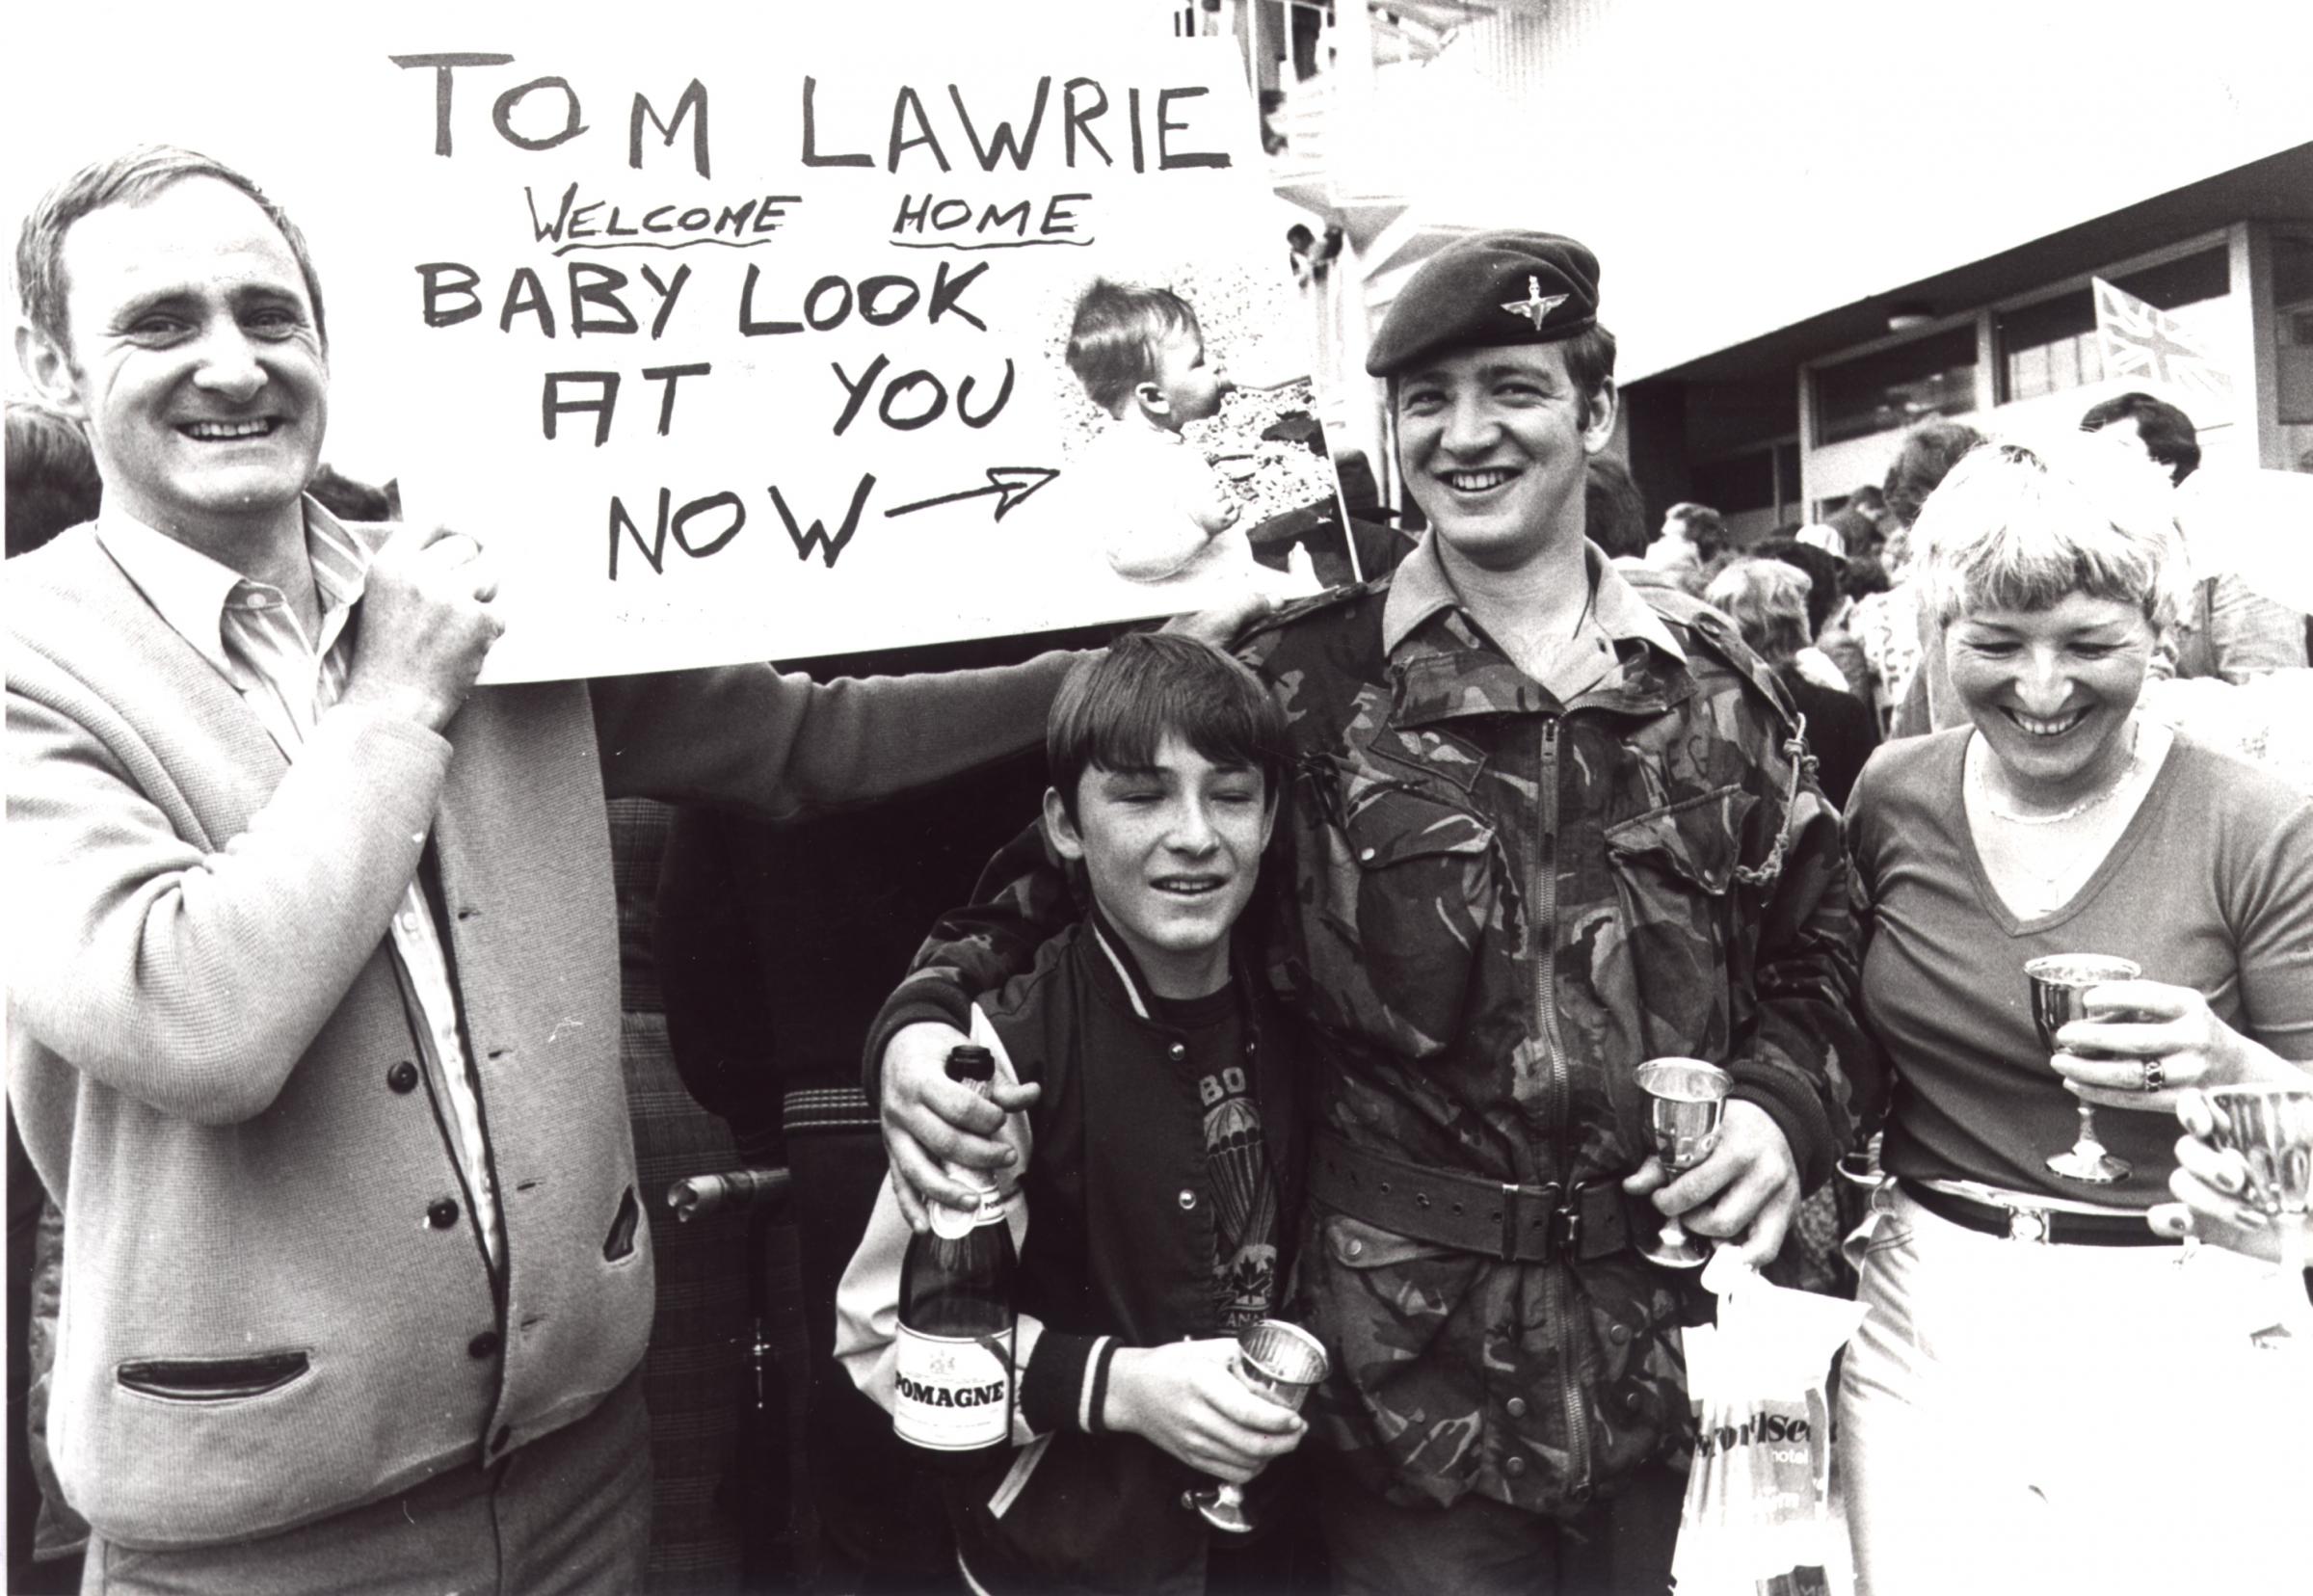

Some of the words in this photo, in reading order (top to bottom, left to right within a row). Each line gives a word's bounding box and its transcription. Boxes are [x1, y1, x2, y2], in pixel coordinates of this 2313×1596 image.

[389, 52, 710, 179] TOM
[803, 76, 1232, 173] LAWRIE
[525, 183, 802, 243] WELCOME
[893, 194, 1092, 235] HOME
[416, 263, 692, 339] BABY
[739, 262, 990, 337] LOOK
[543, 363, 711, 447] AT
[832, 354, 1015, 437] YOU
[609, 473, 876, 581] NOW
